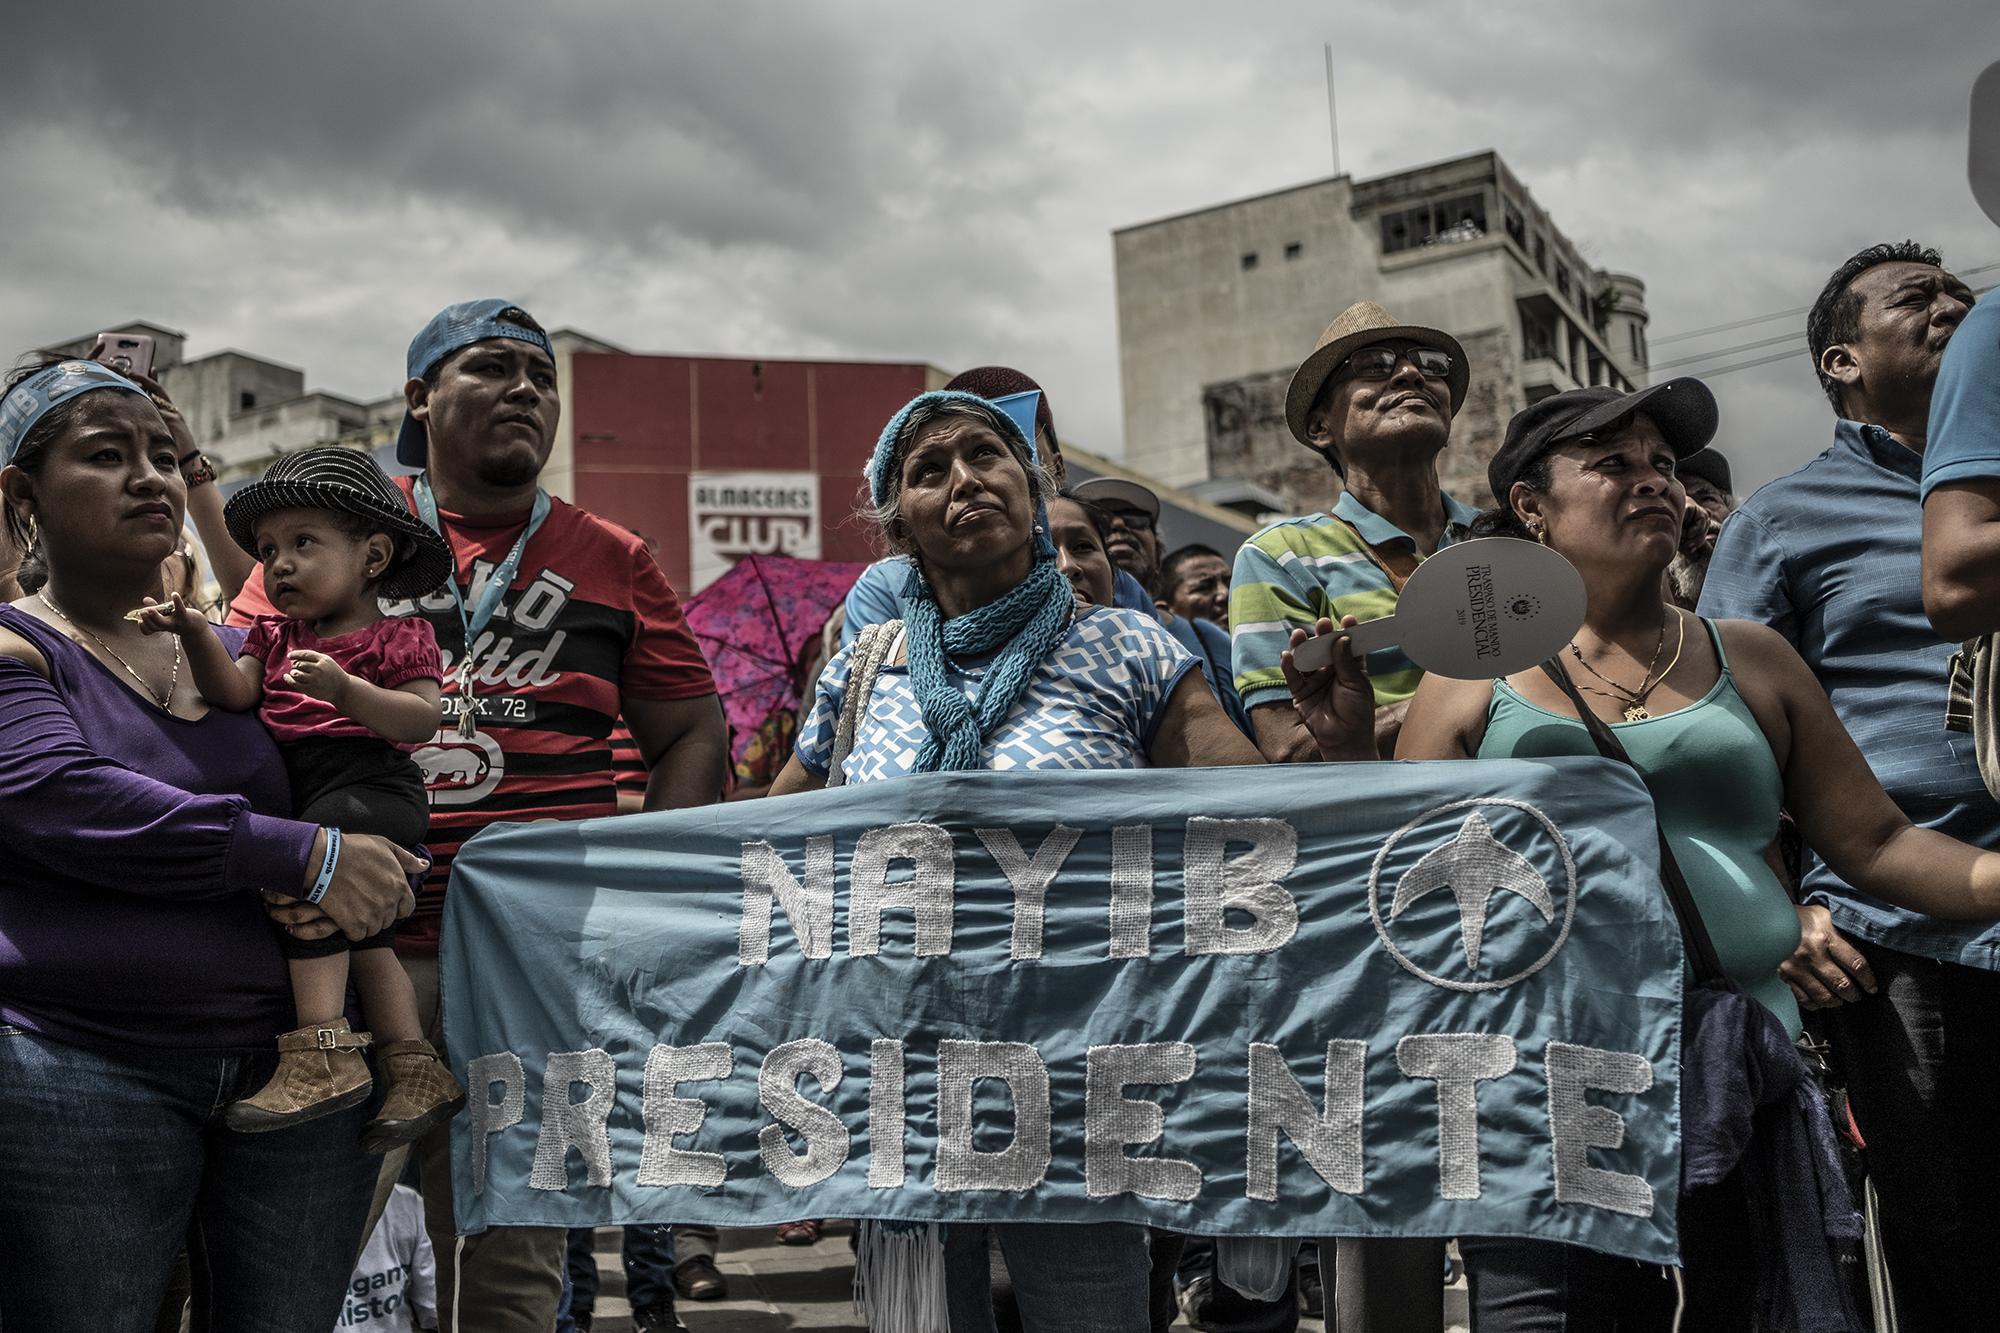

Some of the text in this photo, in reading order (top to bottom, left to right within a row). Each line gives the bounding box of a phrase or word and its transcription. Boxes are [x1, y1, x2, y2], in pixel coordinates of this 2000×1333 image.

[697, 487, 810, 509] ALMACENES
[702, 516, 805, 555] CLUB
[1456, 608, 1467, 626] 2019
[1466, 566, 1491, 660] PRESIDENCIAL
[1480, 564, 1501, 658] TRASPASO DE MANDO
[501, 697, 527, 717] 72
[738, 816, 1299, 967] NAYIB
[466, 1033, 1654, 1218] PRESIDENTE
